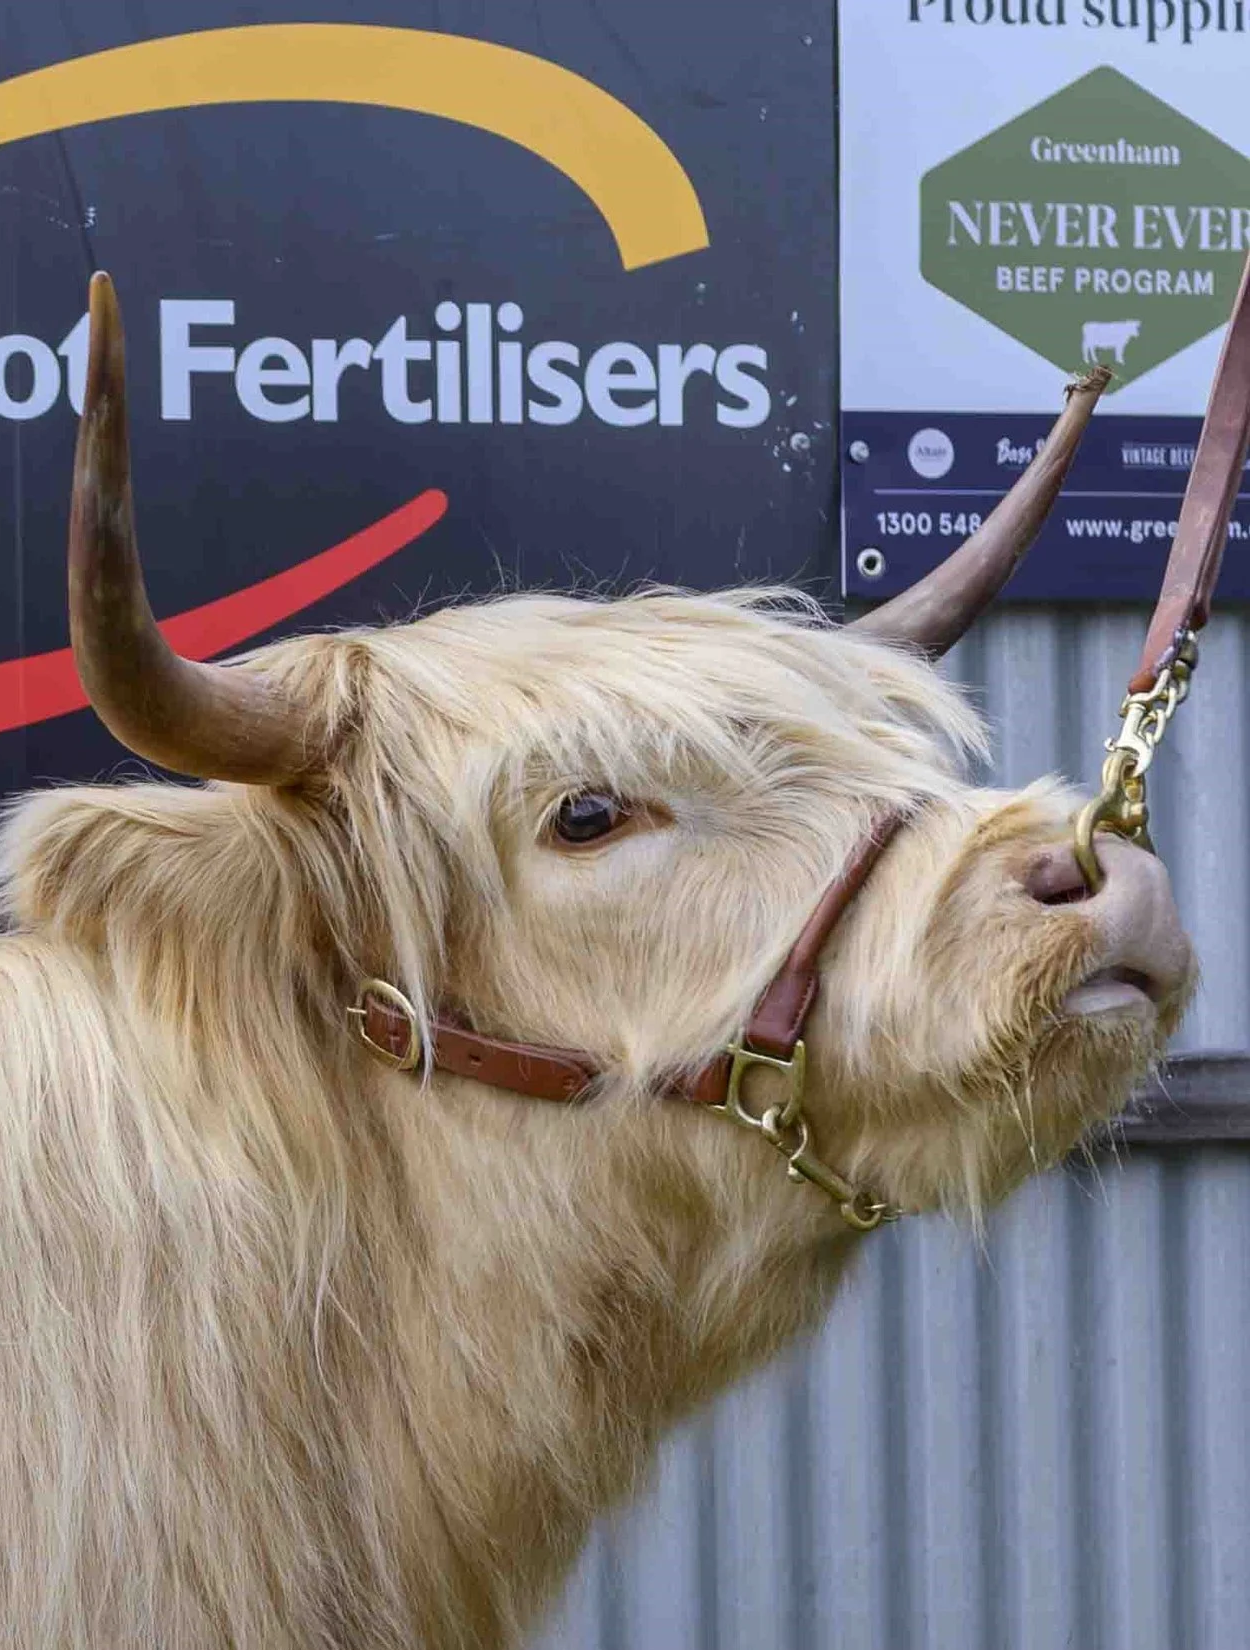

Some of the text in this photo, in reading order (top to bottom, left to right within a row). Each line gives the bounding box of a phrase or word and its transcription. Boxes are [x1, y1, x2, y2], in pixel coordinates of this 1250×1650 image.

[1081, 0, 1250, 44] suppli
[1030, 135, 1182, 167] Greenham
[947, 199, 1250, 253] NEVER EVER
[996, 264, 1215, 296] BEEF PROGRAM
[160, 299, 772, 428] Fertilisers
[1121, 446, 1167, 466] VINTAGE
[877, 512, 981, 536] 1300 548
